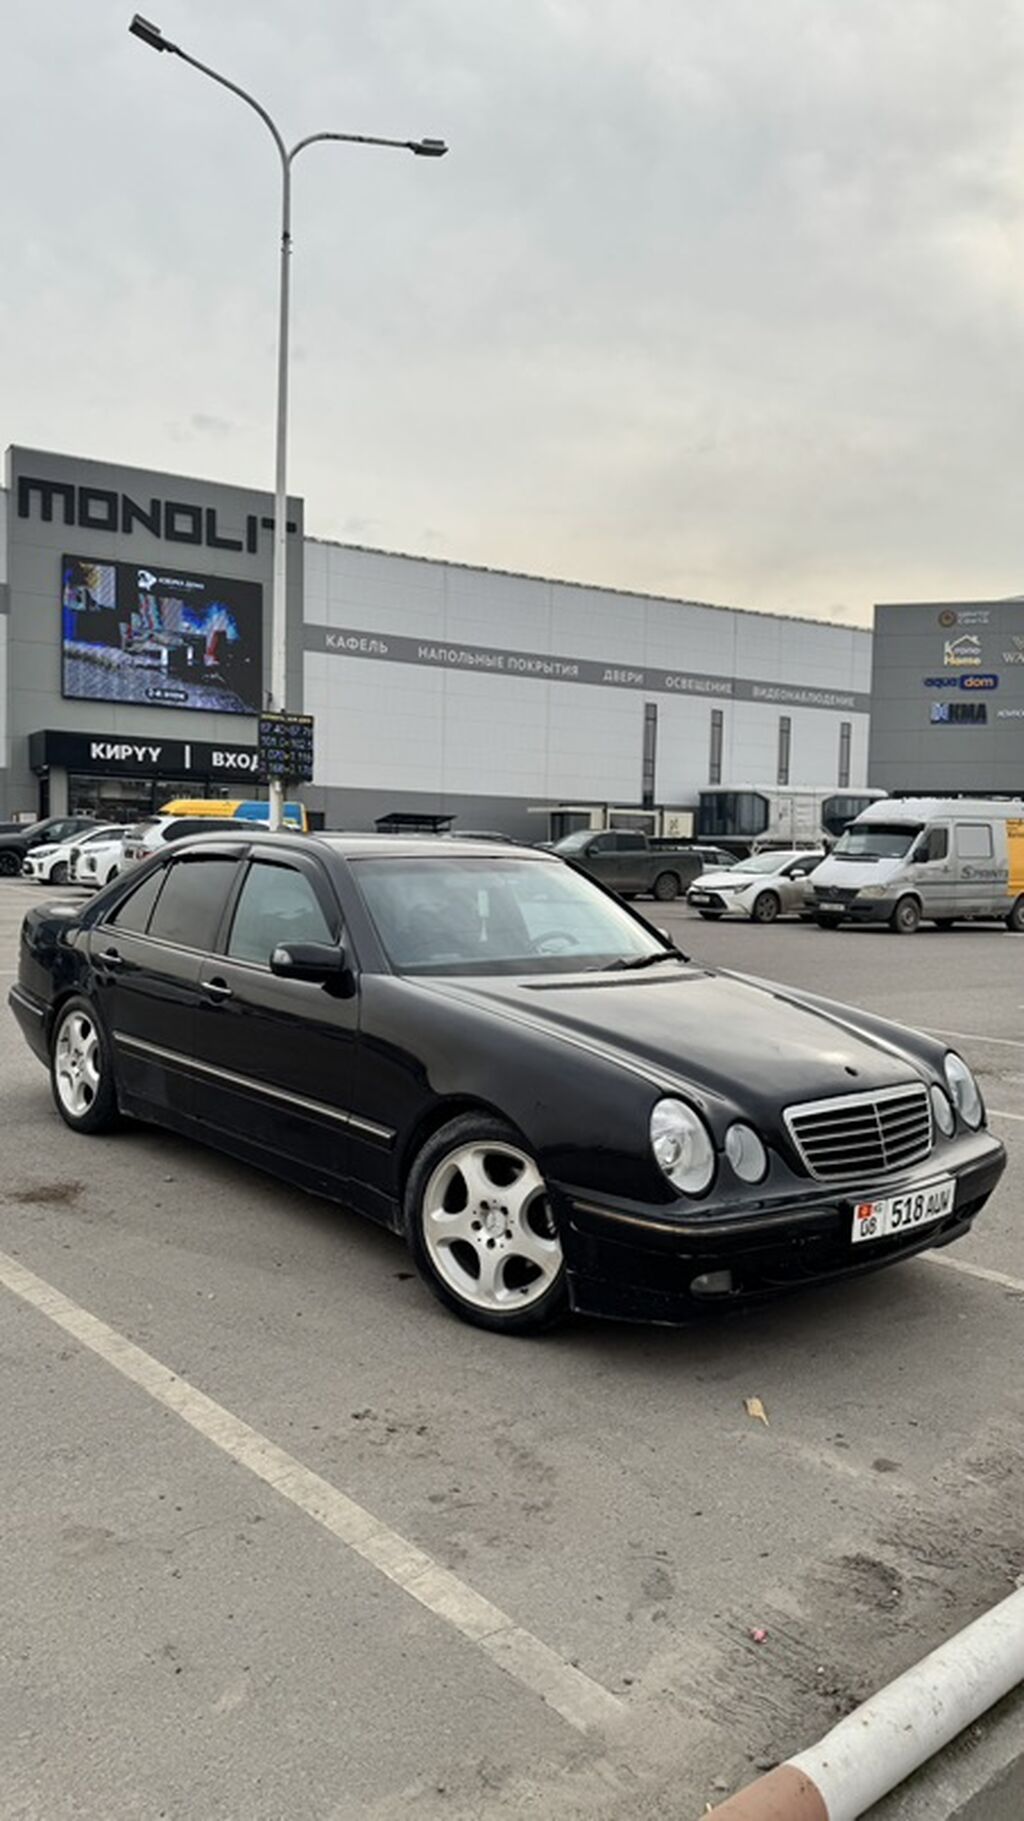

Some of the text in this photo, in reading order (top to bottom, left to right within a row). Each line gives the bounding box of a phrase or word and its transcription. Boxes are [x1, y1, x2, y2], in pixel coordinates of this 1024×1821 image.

[325, 634, 855, 708] КАФЕЛЬ НАПОЛЬНЫЕ ПОКРЫТИЯ ДВЕРИ ОСВЕЩЕНИЕ ВИДЕОНАБЛЮДЕНИЕ
[964, 676, 994, 688] dom
[891, 1194, 925, 1228] 518
